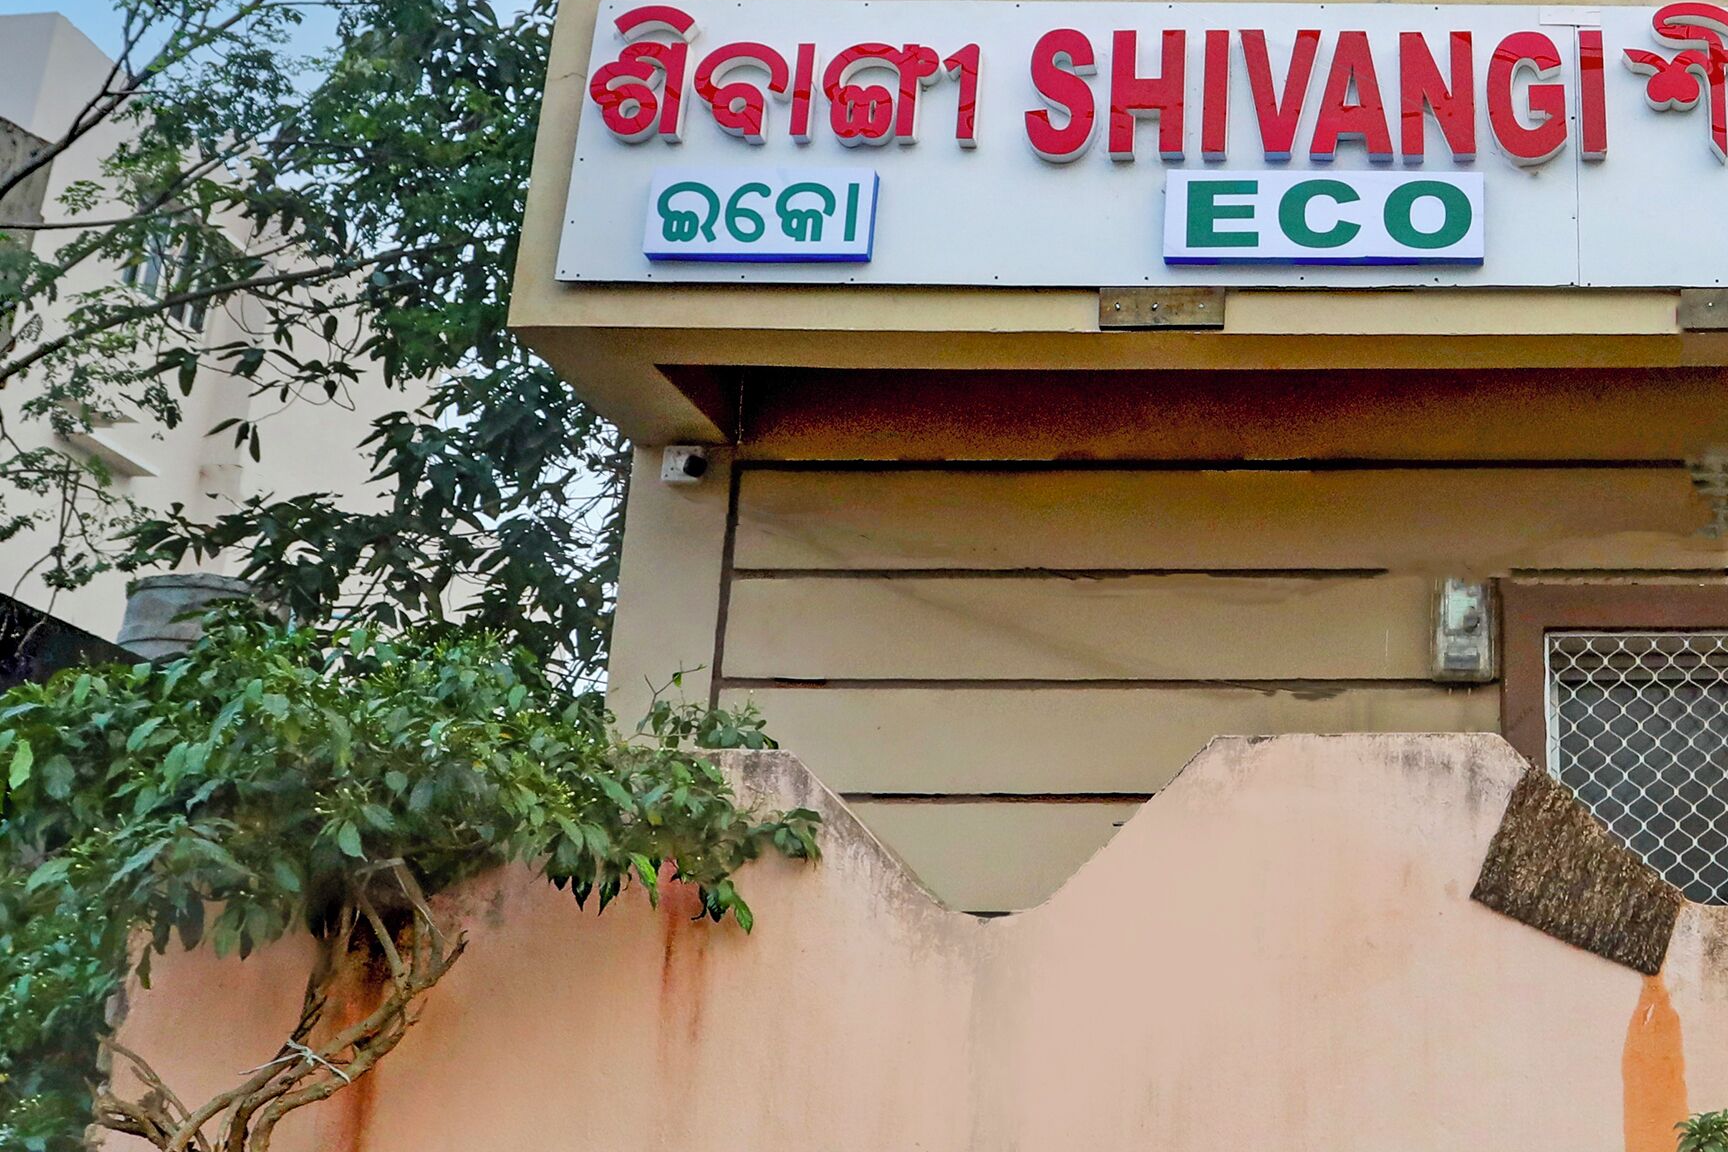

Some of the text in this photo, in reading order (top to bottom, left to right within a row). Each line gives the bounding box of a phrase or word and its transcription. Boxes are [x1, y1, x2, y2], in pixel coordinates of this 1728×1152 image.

[1026, 29, 1606, 158] SHIVANGI
[661, 183, 858, 242] ଇକୋ
[1187, 180, 1472, 249] ECO
